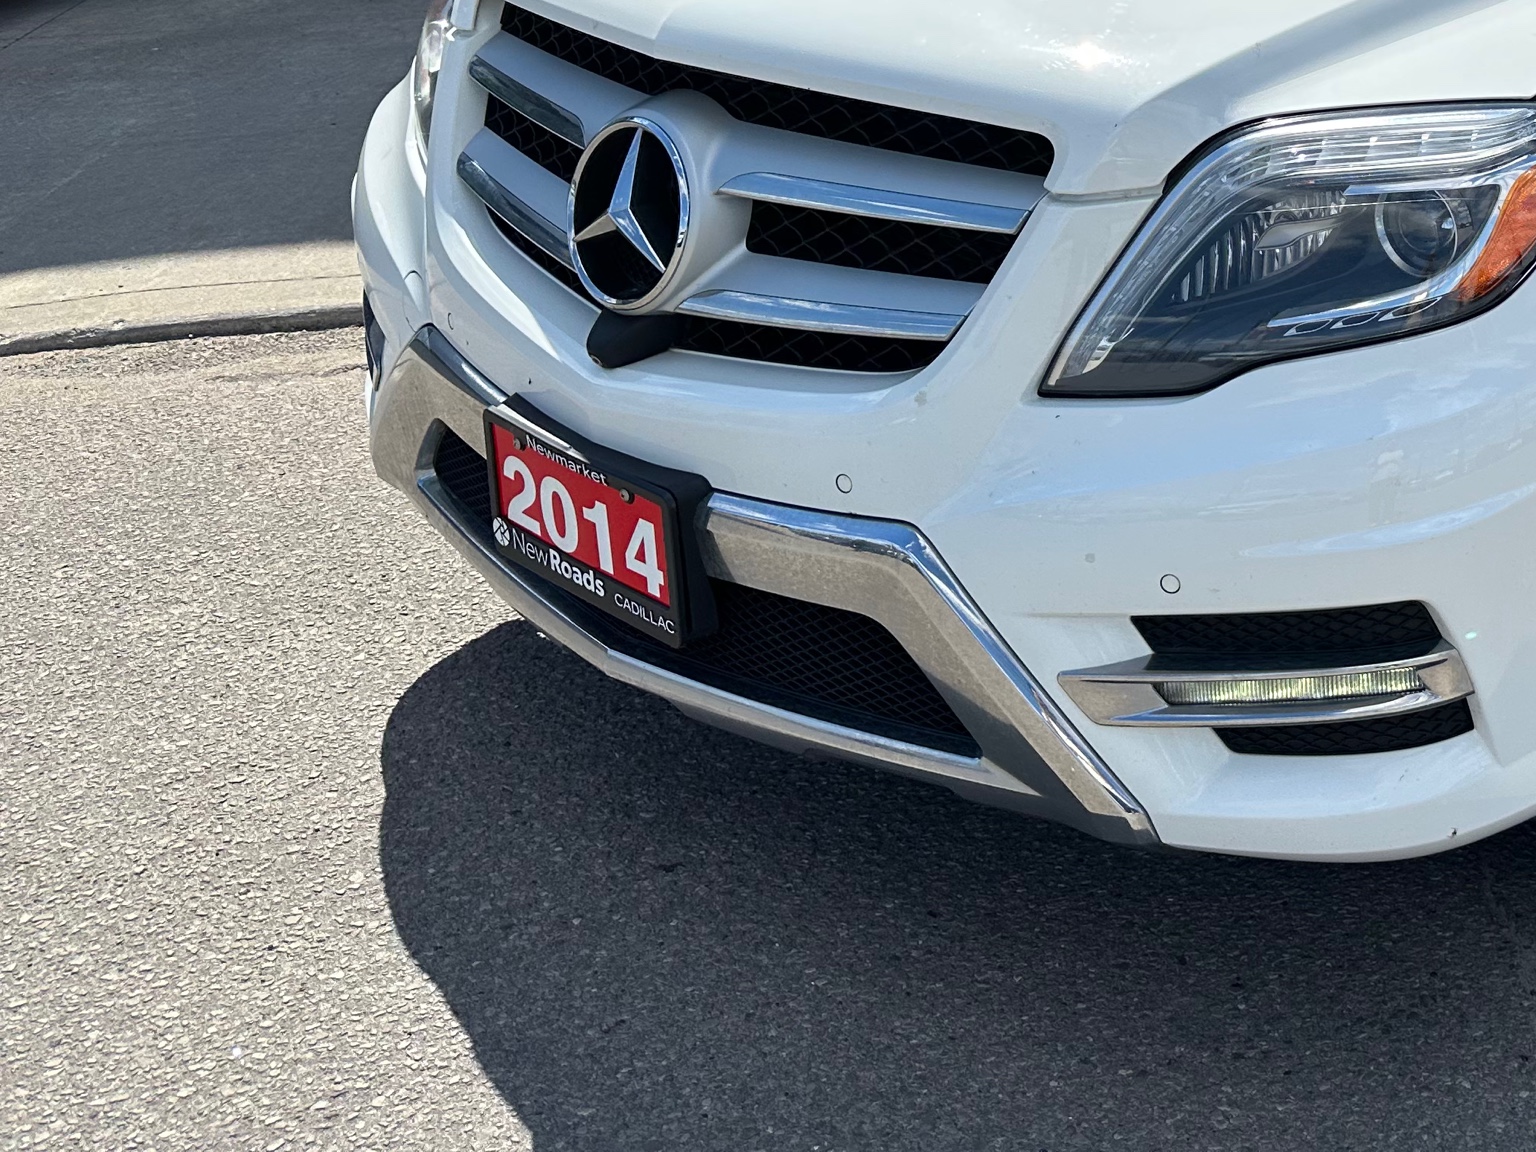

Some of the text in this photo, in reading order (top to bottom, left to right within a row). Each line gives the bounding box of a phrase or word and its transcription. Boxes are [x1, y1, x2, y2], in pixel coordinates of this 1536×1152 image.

[526, 435, 608, 485] Newmarket
[503, 455, 664, 598] 2014
[614, 593, 675, 635] CADILLAC
